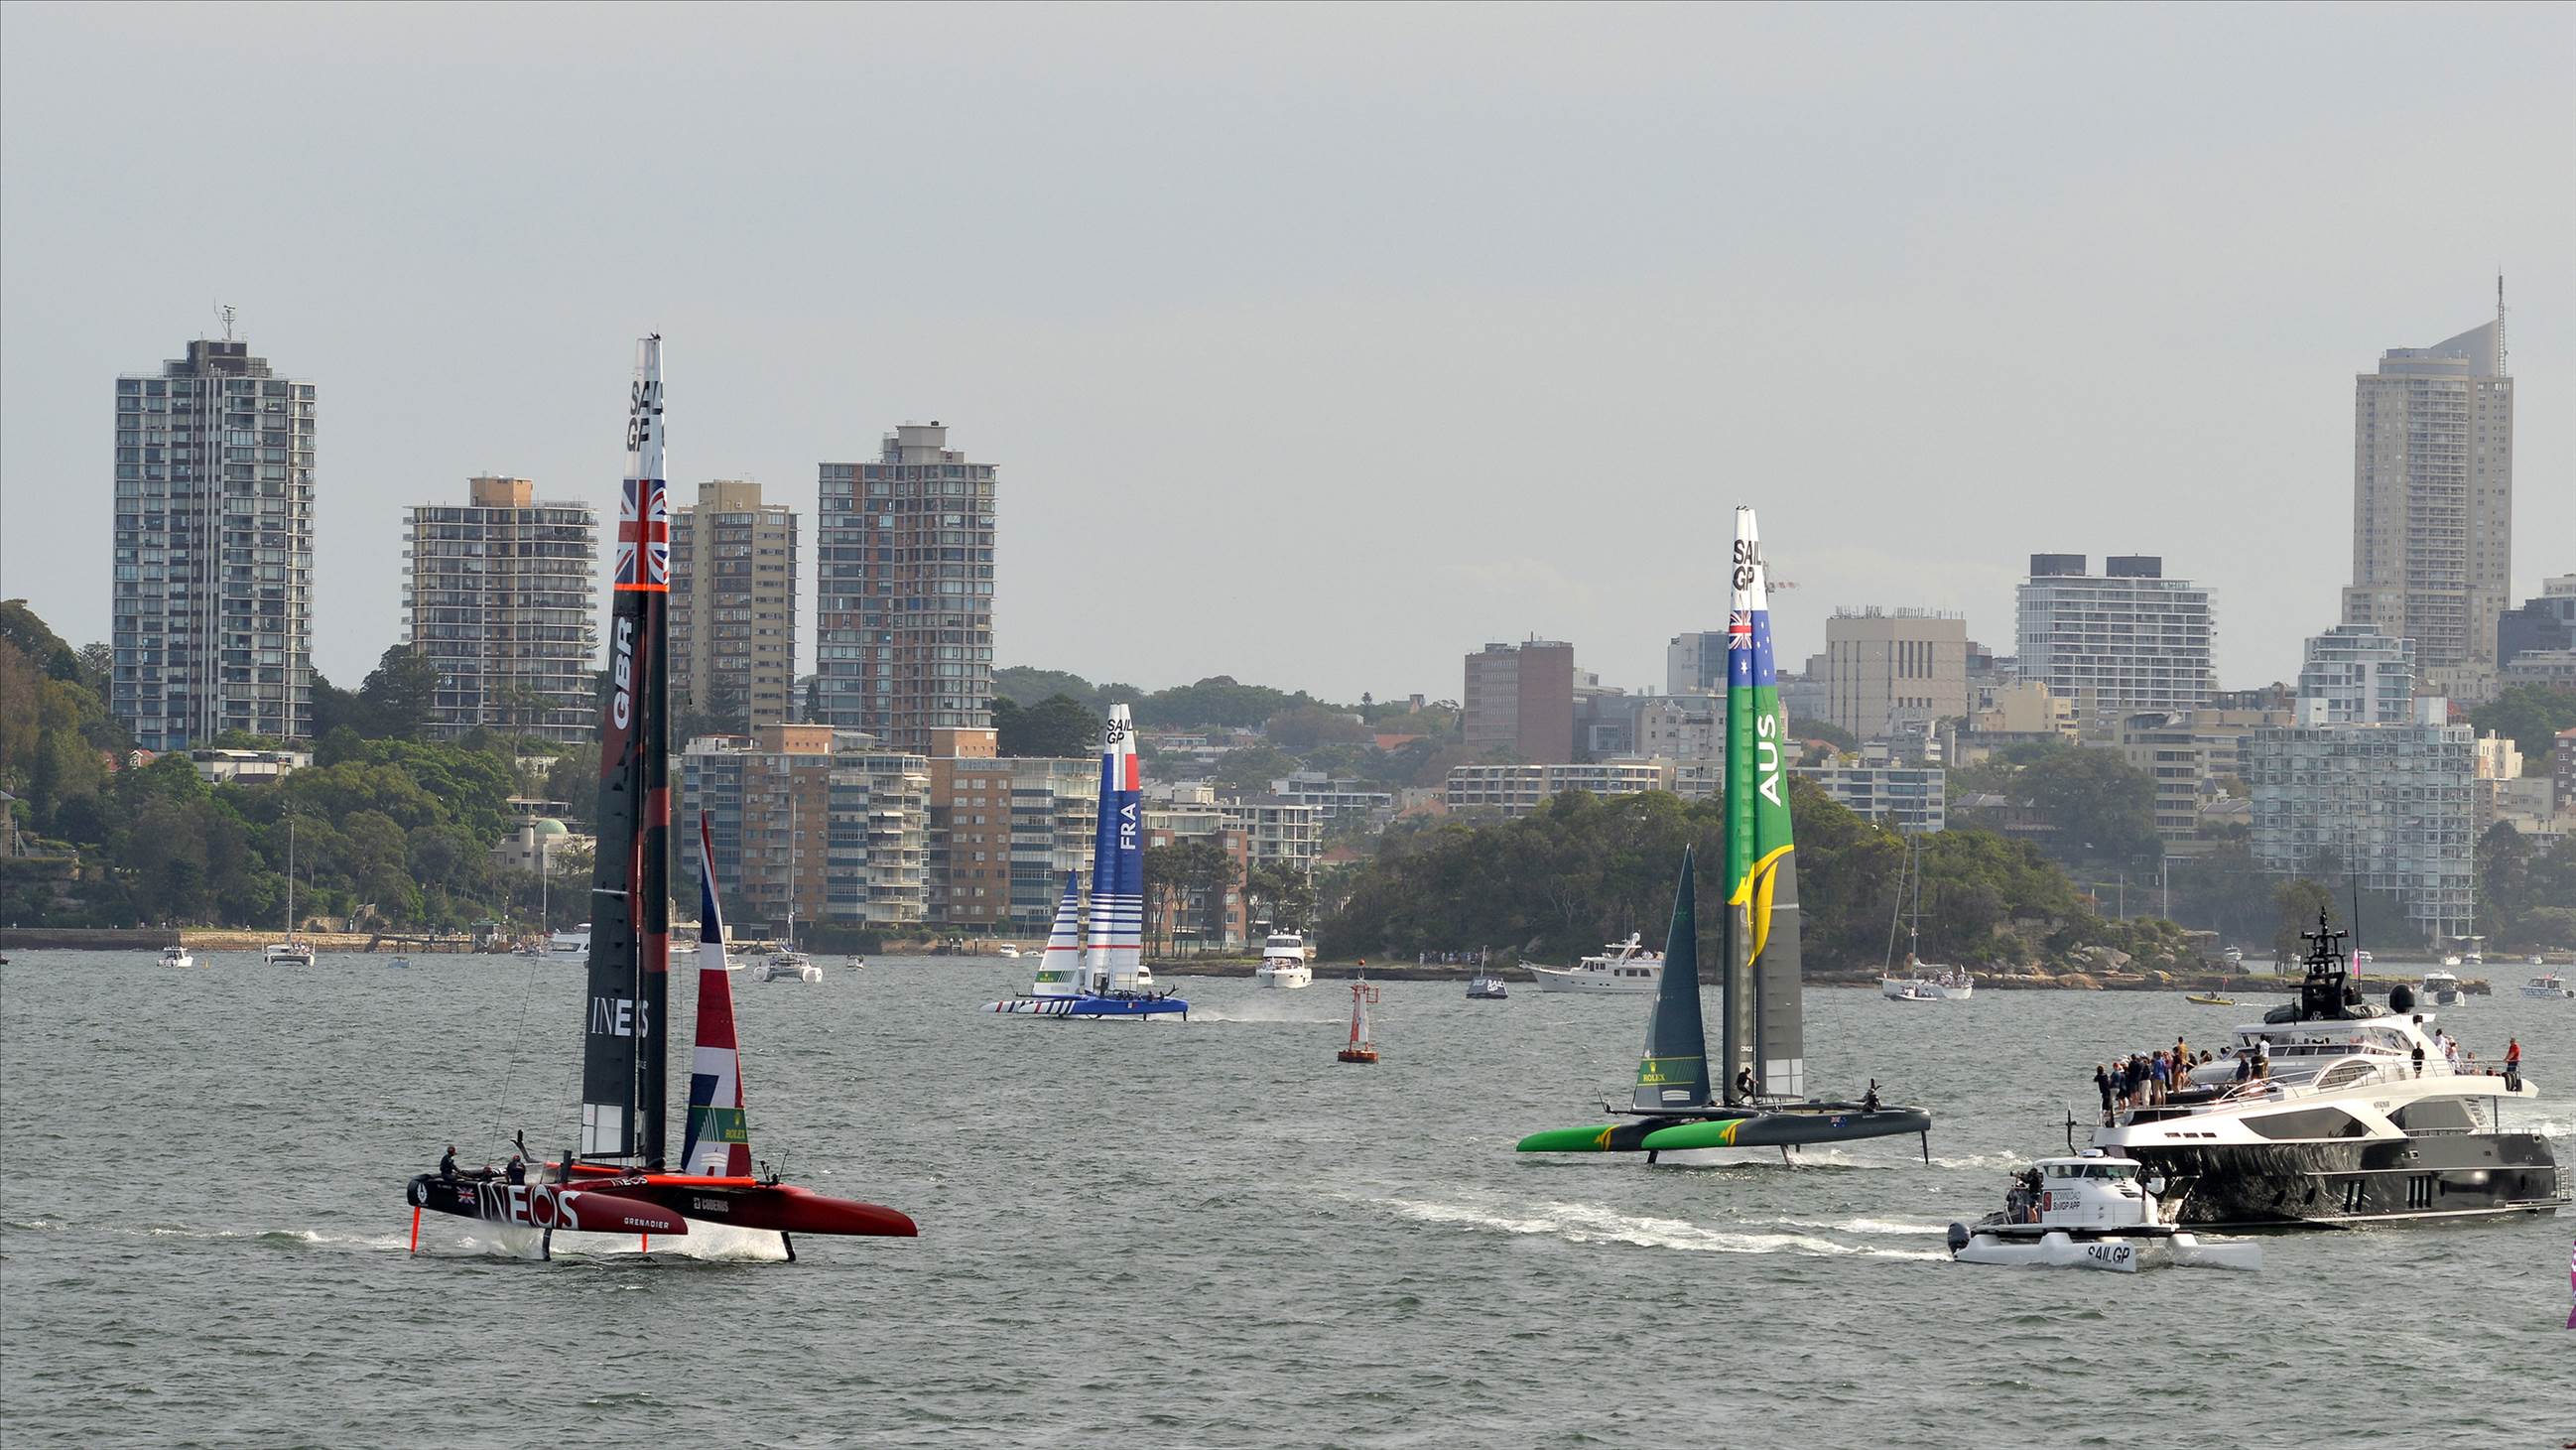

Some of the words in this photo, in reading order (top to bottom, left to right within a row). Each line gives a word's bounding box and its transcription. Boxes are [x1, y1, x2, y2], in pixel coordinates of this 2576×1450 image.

[1733, 539, 1762, 566] SAIL
[1733, 565, 1755, 592] GP
[613, 616, 633, 730] GBR
[1106, 719, 1133, 732] SAIL
[1106, 731, 1125, 744] GP
[1757, 714, 1781, 808] AUS
[1120, 802, 1136, 851] FRA
[590, 996, 649, 1038] INES
[477, 1181, 580, 1231] INEOS
[623, 1216, 670, 1230] GRENADIER
